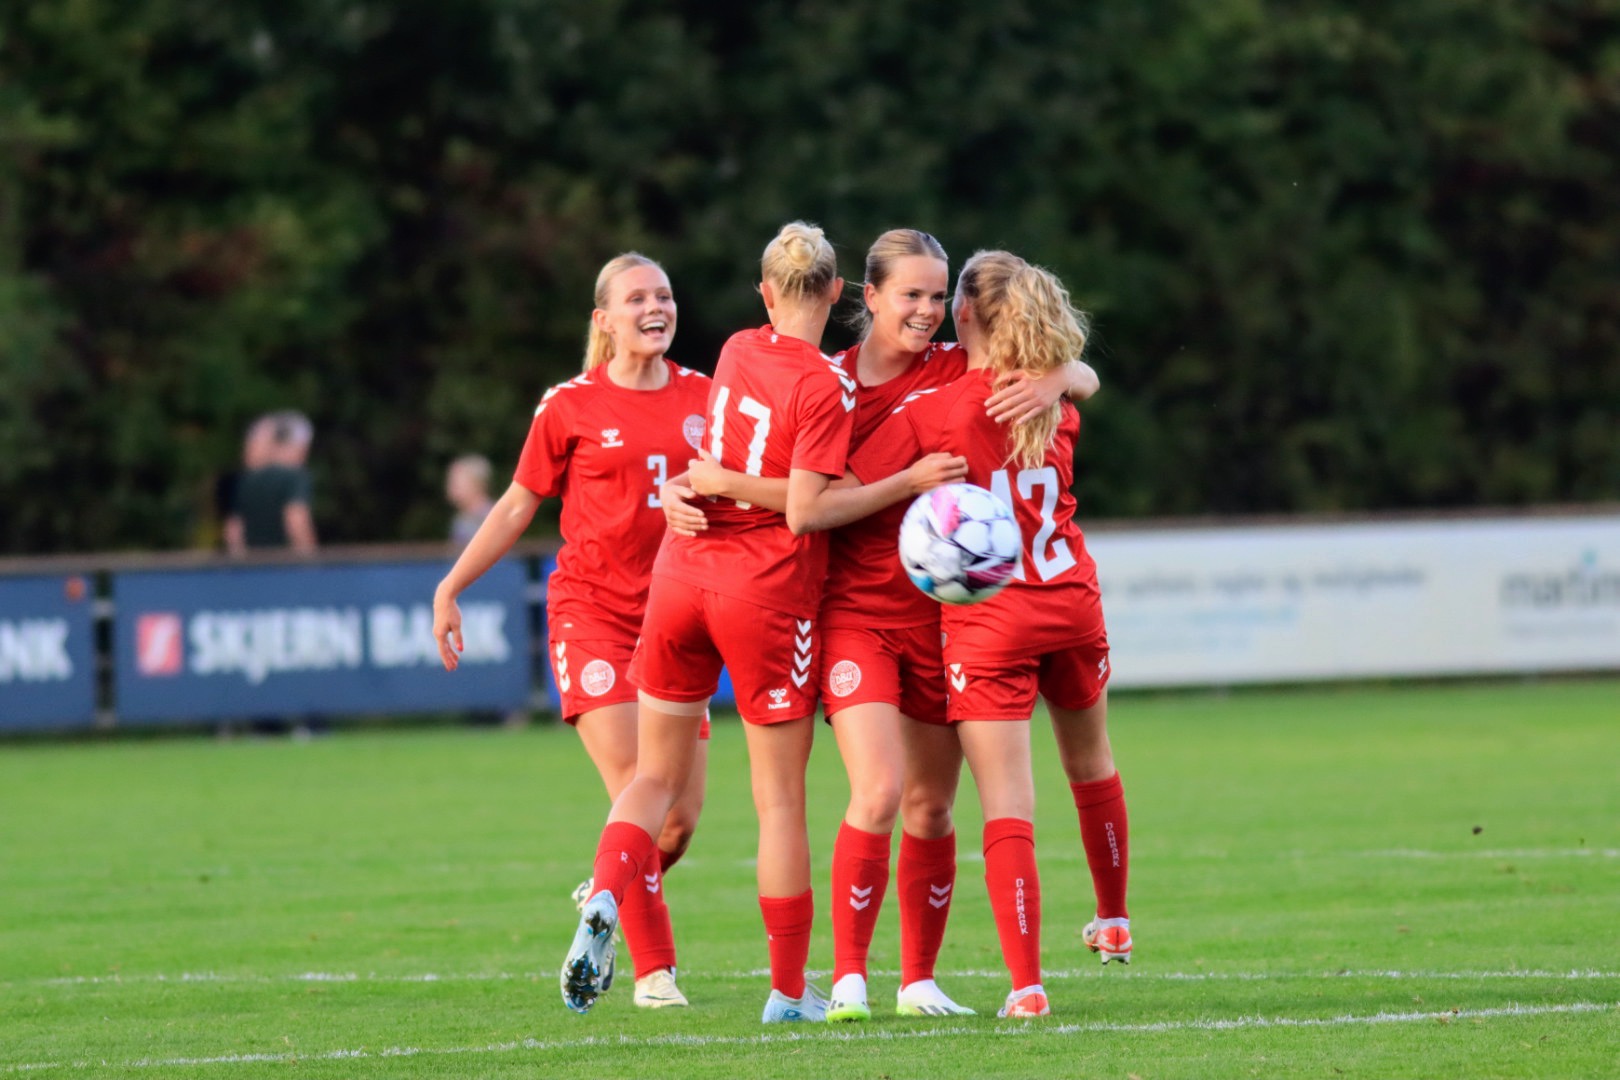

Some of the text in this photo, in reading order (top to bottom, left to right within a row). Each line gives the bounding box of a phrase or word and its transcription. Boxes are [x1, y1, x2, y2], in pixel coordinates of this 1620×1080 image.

[704, 385, 771, 511] 17
[647, 454, 667, 508] 3
[1105, 822, 1120, 868] DANMARK
[1016, 878, 1029, 935] DANMARK
